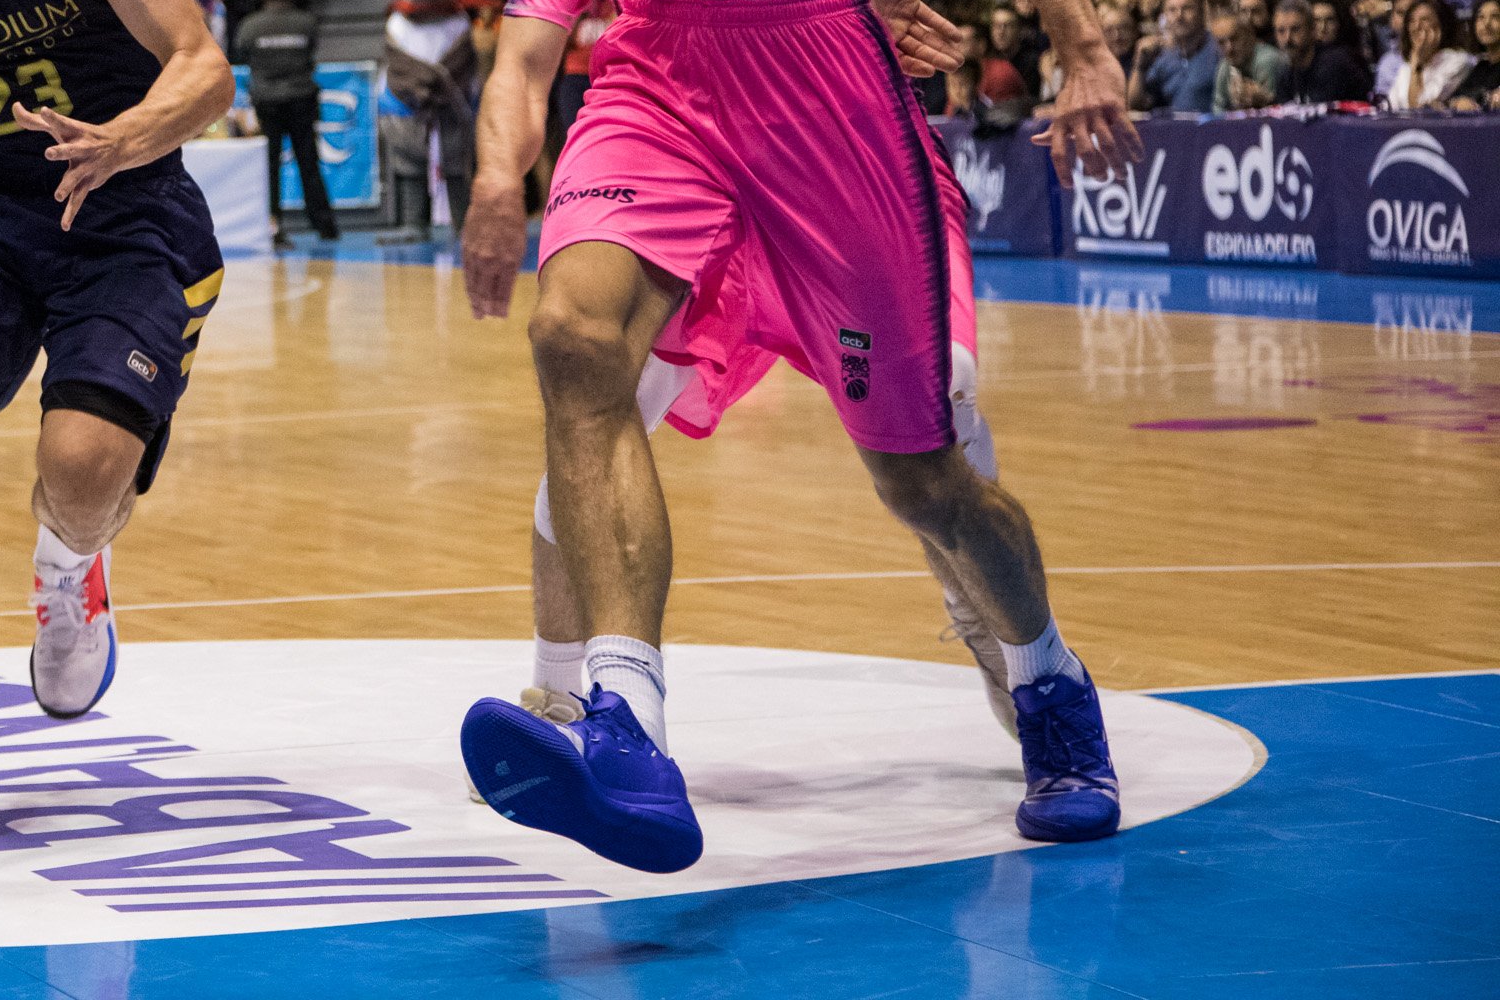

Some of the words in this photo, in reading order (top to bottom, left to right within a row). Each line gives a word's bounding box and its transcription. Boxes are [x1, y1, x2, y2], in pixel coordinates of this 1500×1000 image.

[1367, 199, 1470, 251] OVIGA
[841, 336, 864, 348] acb
[131, 358, 150, 376] acb
